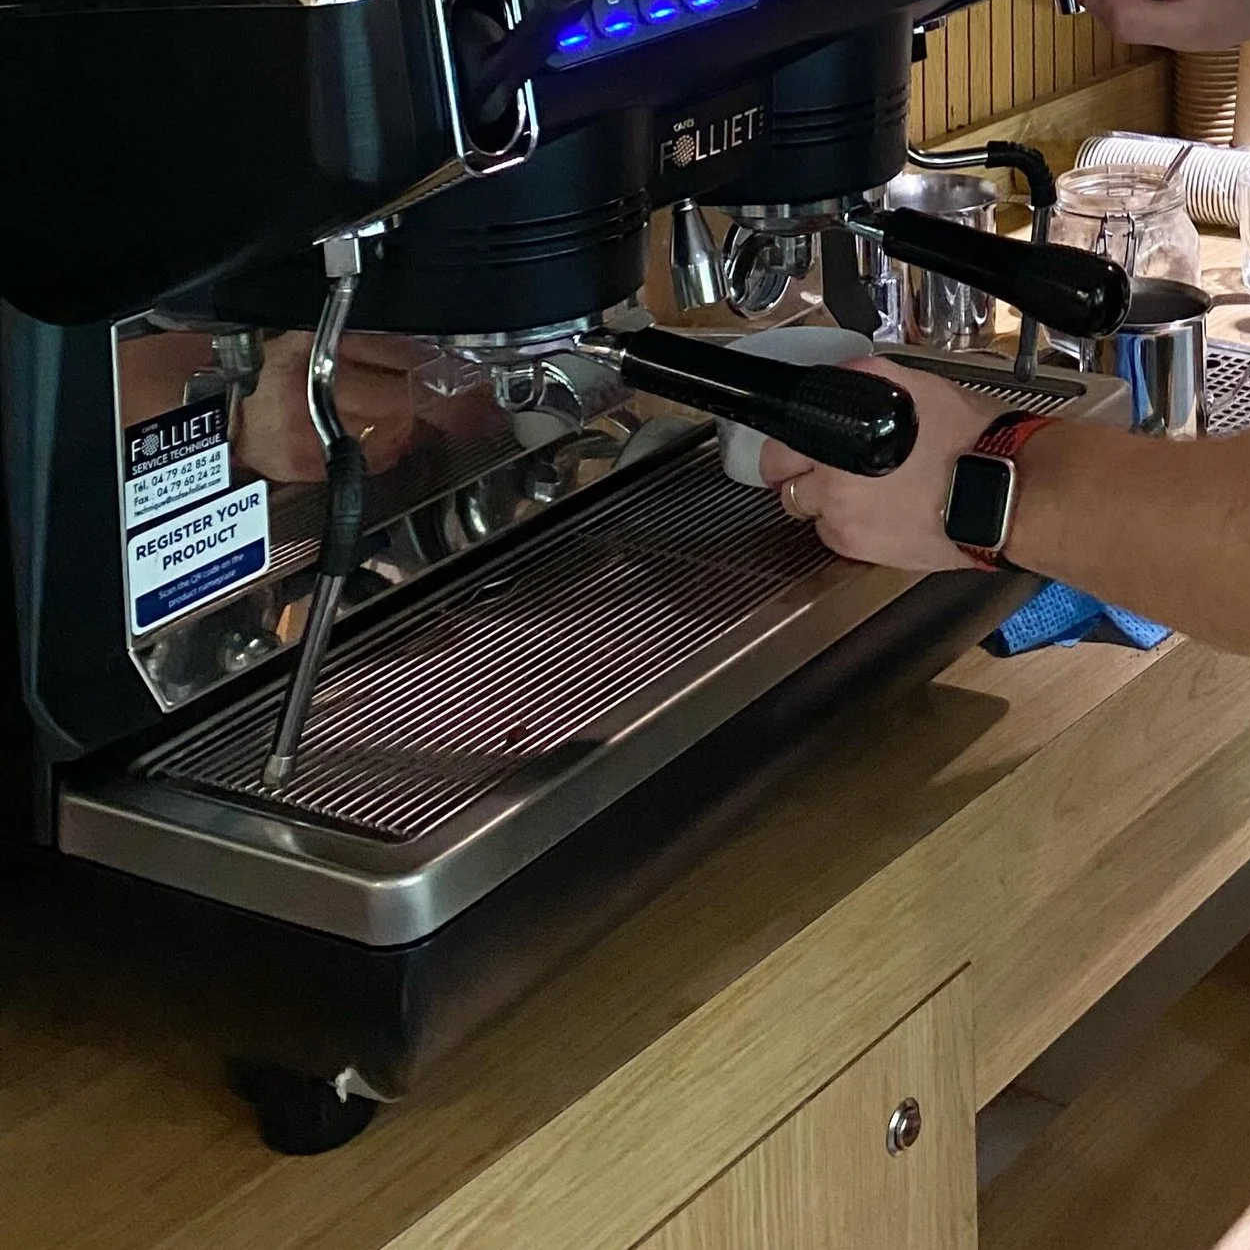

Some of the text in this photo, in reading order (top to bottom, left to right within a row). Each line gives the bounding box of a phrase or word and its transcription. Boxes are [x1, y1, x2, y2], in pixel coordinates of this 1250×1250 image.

[132, 411, 213, 462] FOLLIET
[132, 432, 221, 476] SERVICE TECHNIQUE
[151, 474, 163, 486] 04
[166, 468, 178, 481] 79
[181, 462, 192, 474] 62
[195, 456, 207, 469] 85
[209, 451, 221, 463] 48
[157, 486, 168, 497] 04
[170, 480, 182, 492] 79
[184, 474, 195, 486] 60
[197, 469, 208, 481] 24
[210, 464, 221, 476] 22
[136, 493, 259, 560] REGISTER YOUR
[162, 523, 237, 570] PRODUCT
